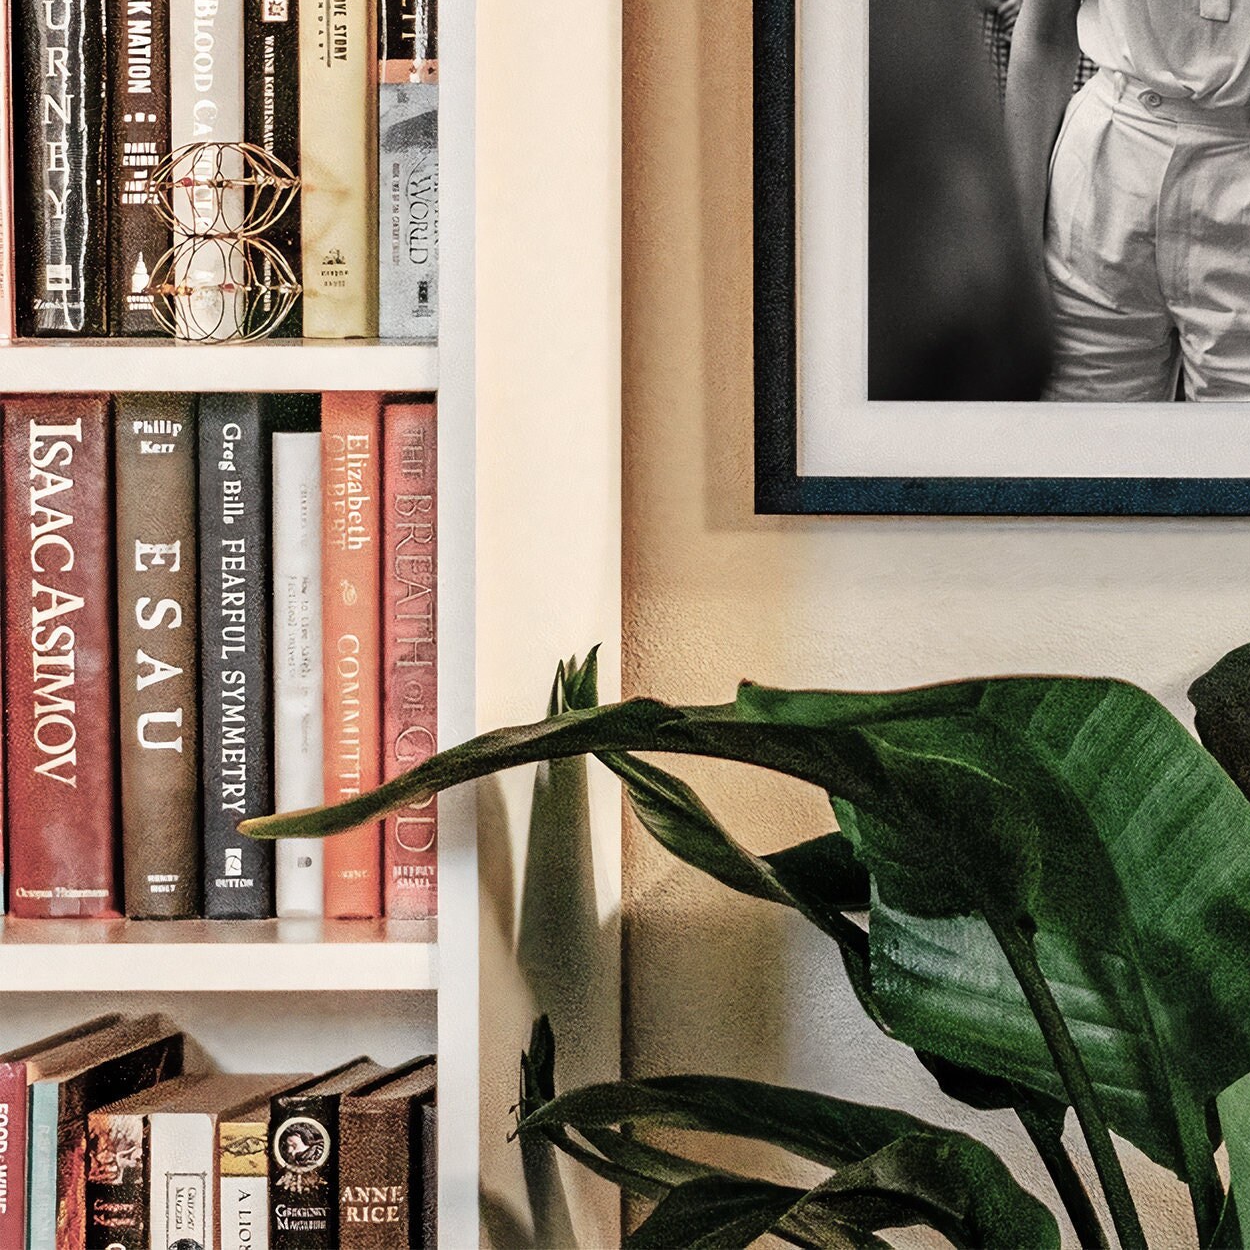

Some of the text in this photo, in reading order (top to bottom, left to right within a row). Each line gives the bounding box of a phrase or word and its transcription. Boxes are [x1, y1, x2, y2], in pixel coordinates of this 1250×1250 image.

[127, 20, 152, 94] NATION
[333, 25, 348, 62] STORY
[409, 175, 432, 265] WORLD
[218, 423, 242, 471] Greg
[402, 427, 425, 479] THE
[347, 433, 371, 551] Elizabeth
[29, 417, 85, 789] ISAAC ASIMOV
[220, 539, 247, 660] FEARFUL
[394, 494, 434, 668] BREATH
[134, 539, 184, 753] ESAU
[220, 669, 247, 815] SYMMETRY
[238, 1189, 251, 1202] A
[341, 1185, 405, 1203] ANNE
[346, 1206, 400, 1223] RICE
